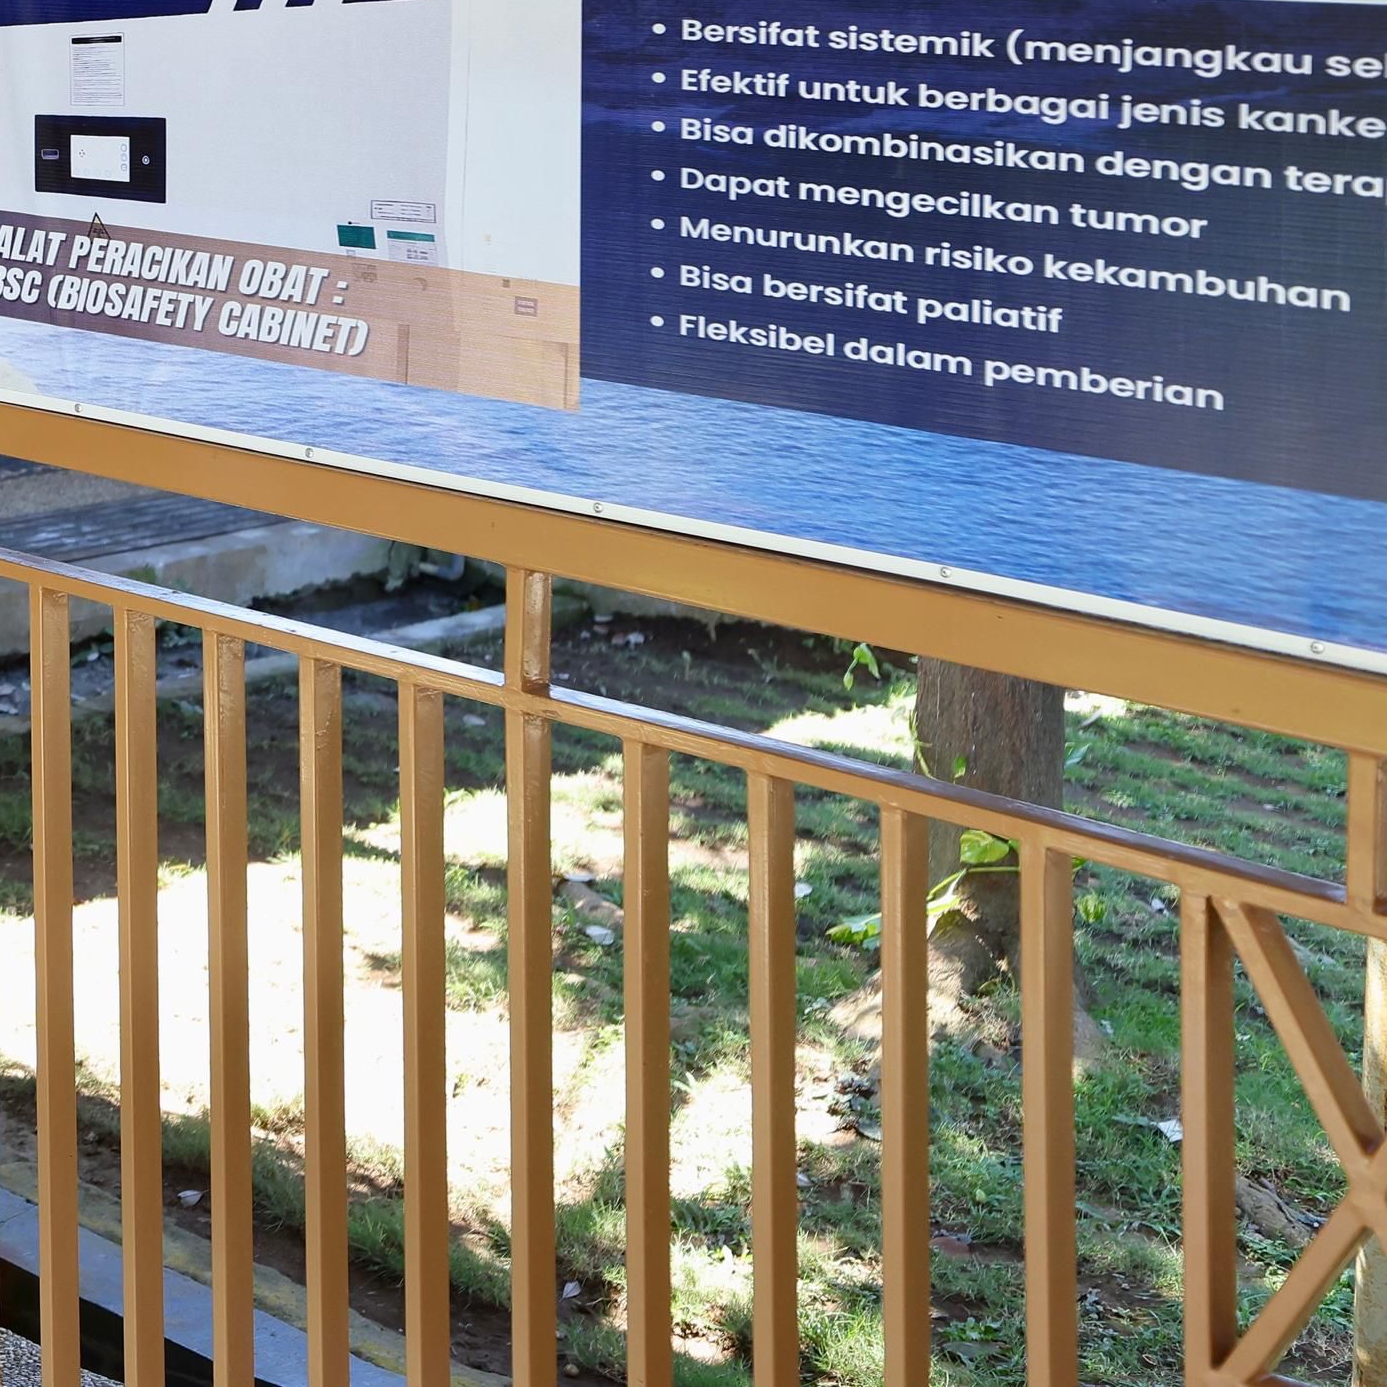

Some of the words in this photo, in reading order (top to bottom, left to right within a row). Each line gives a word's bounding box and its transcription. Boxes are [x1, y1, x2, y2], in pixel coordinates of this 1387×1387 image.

[683, 20, 819, 47] Bersifat
[829, 26, 994, 57] sistemik
[1007, 29, 1312, 77] (menjangkau
[1326, 53, 1387, 82] se
[682, 69, 789, 96] Efektif
[799, 81, 908, 105] untuk
[919, 84, 1109, 124] berbagai
[1118, 95, 1224, 128] jenis
[682, 118, 753, 144] Bisa
[764, 125, 1084, 172] dikombinasikan
[1096, 151, 1271, 190] dengan
[1284, 163, 1387, 204] tera
[681, 168, 789, 200] Dapat
[800, 183, 1058, 224] mengecilkan
[1070, 204, 1207, 238] tumor
[69, 235, 234, 291] PERACIKAN
[239, 260, 330, 304] OBAT
[681, 217, 913, 262] Menurunkan
[926, 243, 1033, 275] risiko
[1045, 254, 1350, 311] kekambuhan
[681, 265, 752, 293] Bisa
[764, 274, 907, 314] bersifat
[918, 299, 1062, 332] paliatif
[48, 275, 214, 331] (BIOSAFETY
[218, 301, 371, 358] CABINET)
[681, 315, 834, 356] Fleksibel
[844, 338, 972, 375] dalam
[985, 361, 1223, 410] pemberian
